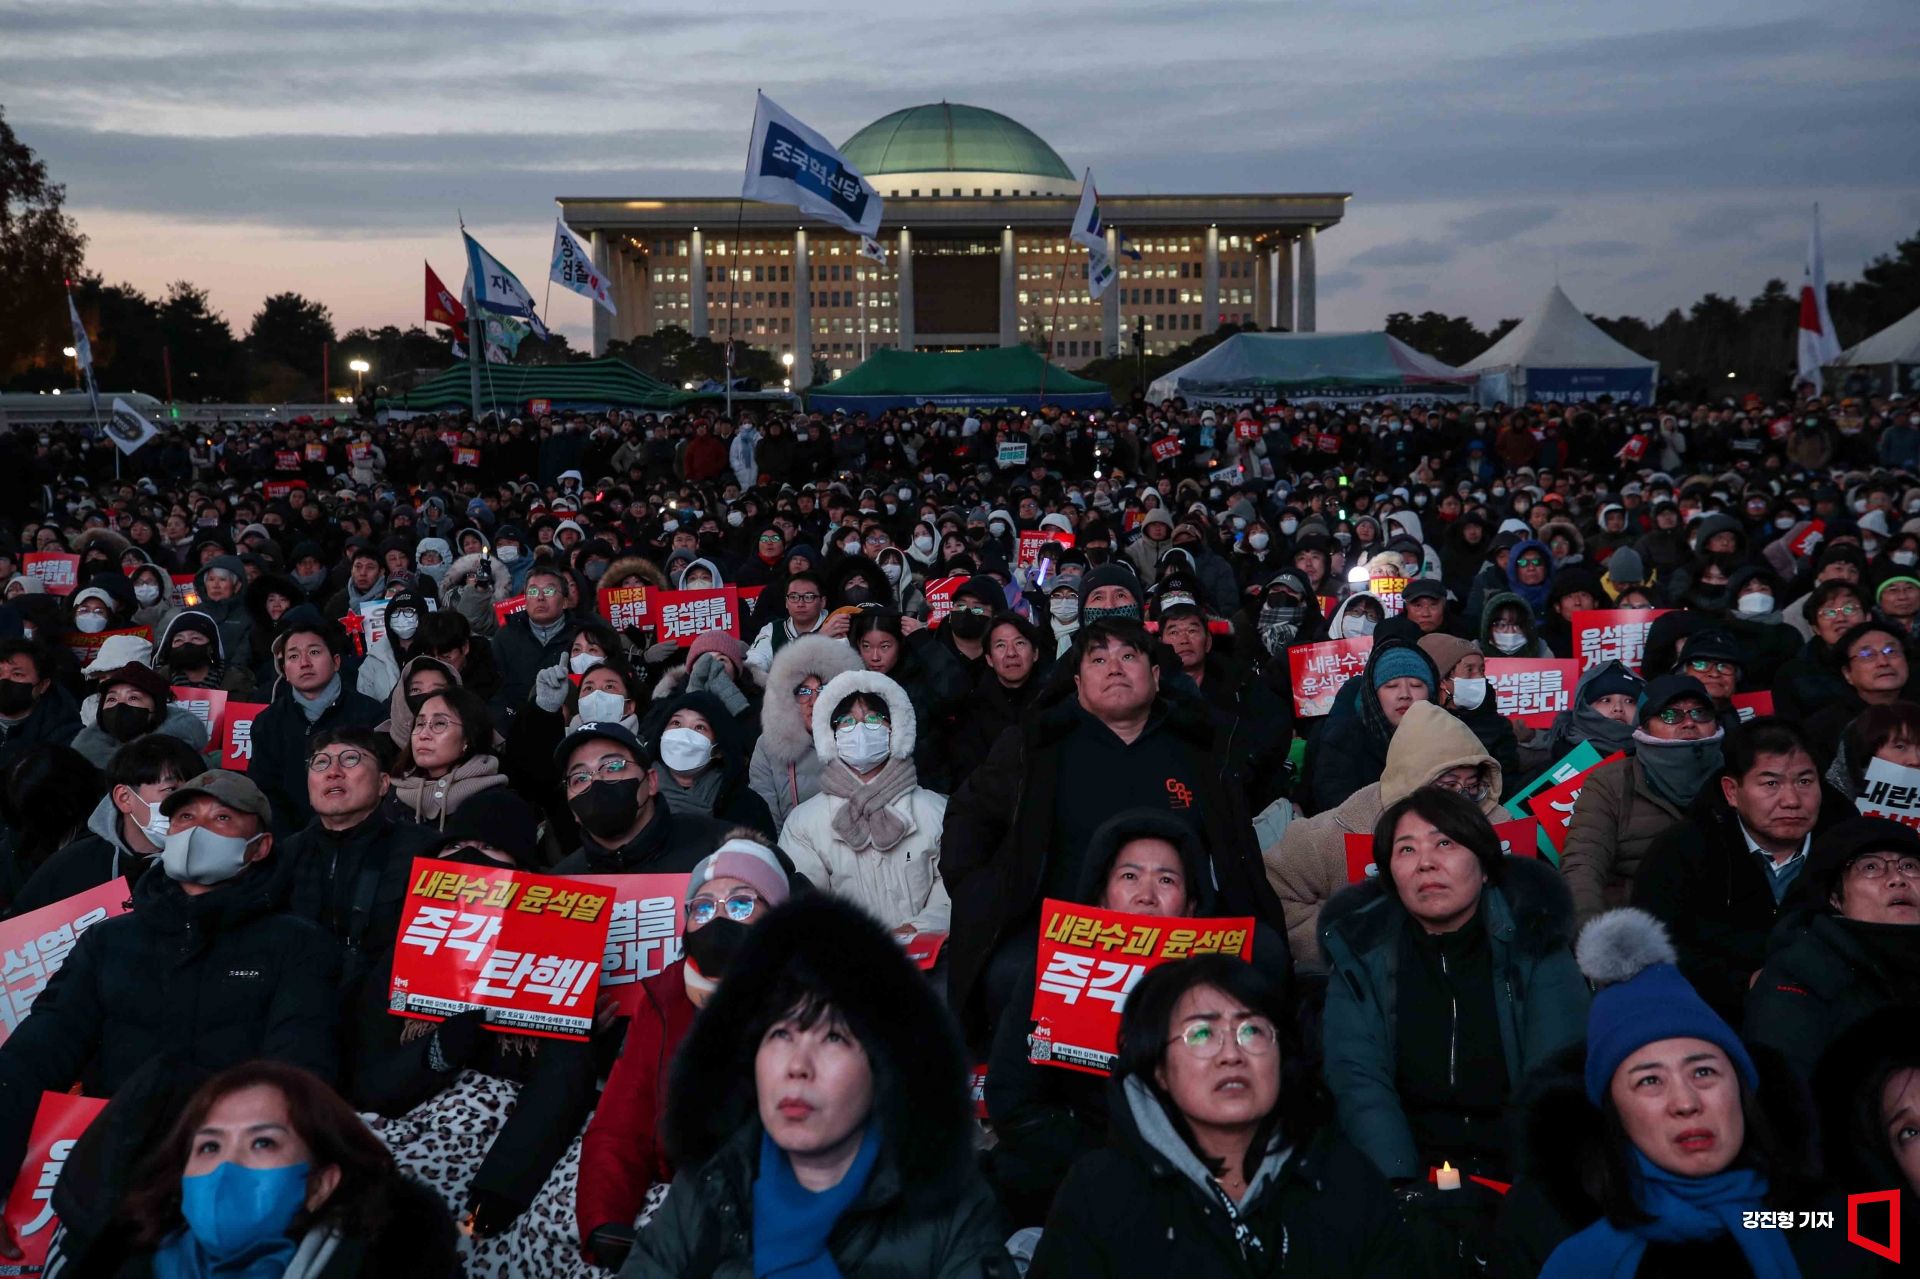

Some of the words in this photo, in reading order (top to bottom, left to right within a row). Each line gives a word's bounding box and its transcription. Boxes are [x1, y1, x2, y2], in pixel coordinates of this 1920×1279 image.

[772, 139, 861, 202] 조국혁신당
[563, 261, 589, 284] 검찰
[608, 586, 647, 605] 내란죄
[610, 600, 648, 616] 윤석열
[663, 596, 727, 622] 윤석열을
[1377, 593, 1405, 609] 석열
[663, 613, 733, 639] 거부한다!
[1581, 622, 1654, 647] 윤석열
[1580, 645, 1643, 673] 거부한
[1488, 670, 1563, 694] 석열을
[1496, 691, 1568, 716] 부한다!
[1858, 779, 1920, 810] 내란
[412, 870, 520, 908] 내란수괴
[517, 885, 607, 923] 윤석열
[606, 897, 676, 944] 열을
[401, 906, 504, 963] 즉각
[1045, 912, 1161, 957] 내란수괴
[1160, 928, 1247, 959] 윤석열
[599, 936, 684, 987] 한다!
[472, 949, 598, 1007] 탄핵!
[1039, 951, 1146, 1014] 즉각
[508, 1011, 524, 1019] 토요일
